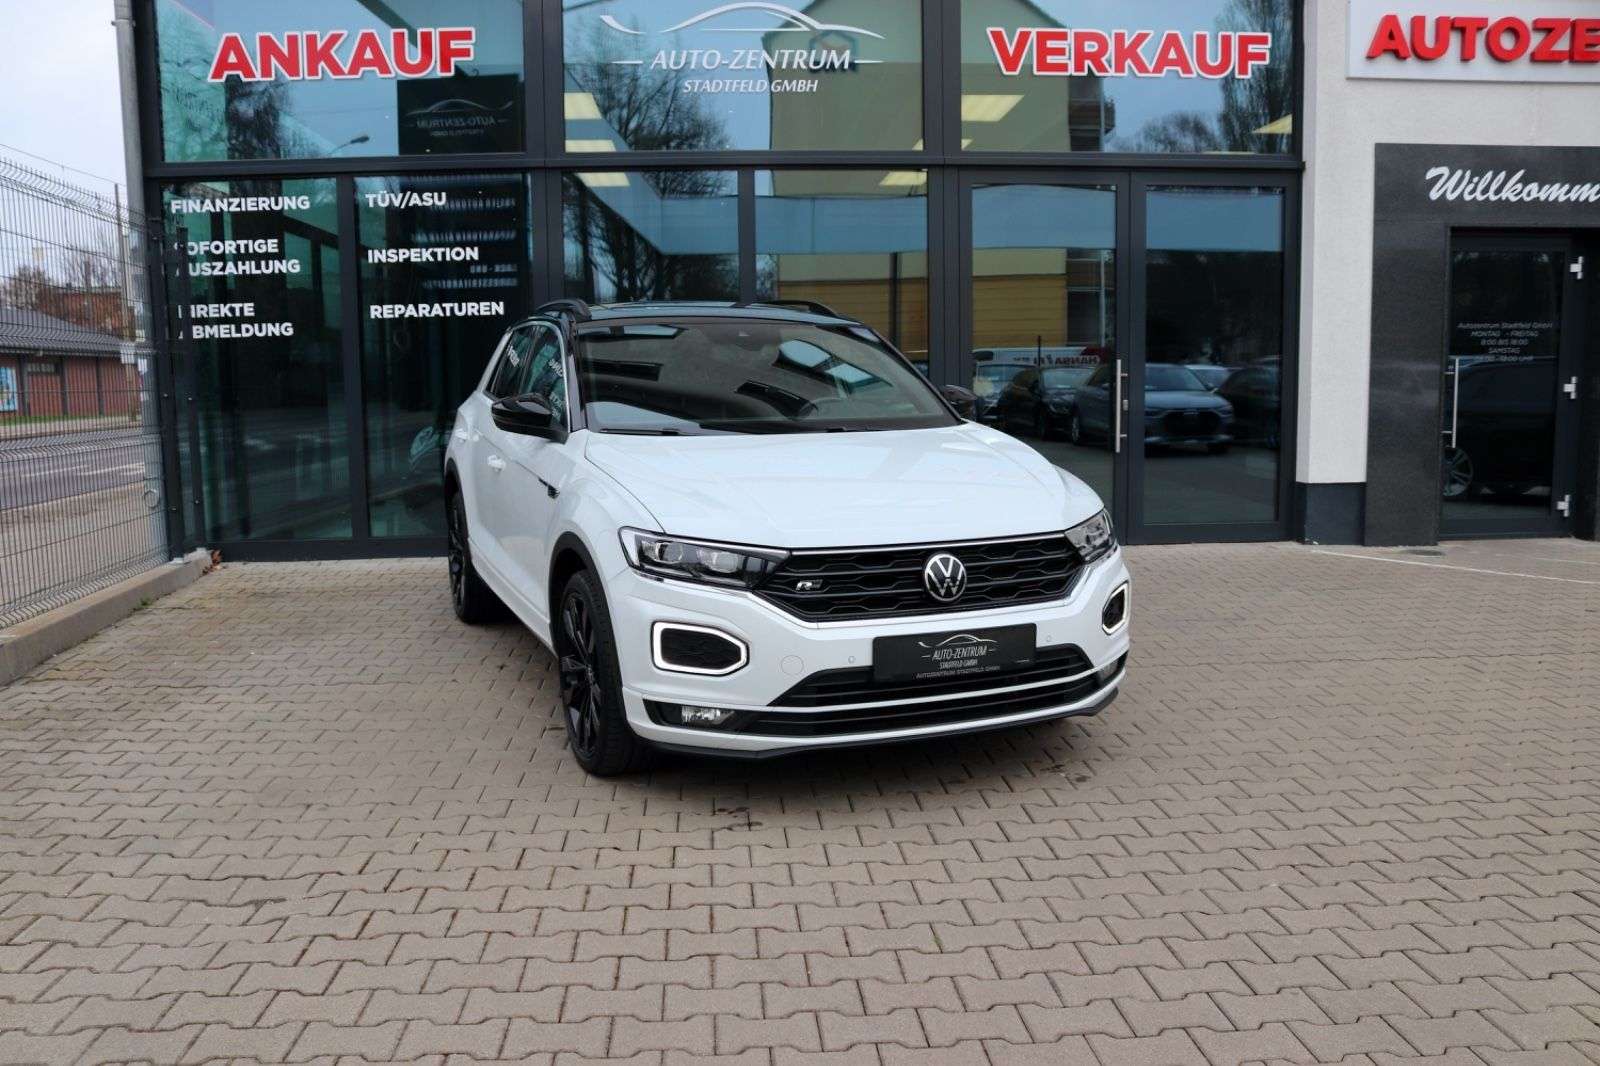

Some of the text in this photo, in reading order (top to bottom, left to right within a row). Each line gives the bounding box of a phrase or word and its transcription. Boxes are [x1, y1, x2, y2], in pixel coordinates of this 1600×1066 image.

[1365, 14, 1600, 64] AUTOZE
[208, 27, 475, 82] ANKAUF
[650, 49, 851, 71] AUTO-ZENTRUM
[986, 27, 1271, 79] VERKAUF
[683, 78, 819, 93] STADTFELD GMBH
[1425, 165, 1600, 203] Willkomm
[171, 195, 311, 214] FINANZIERUNG
[365, 190, 447, 209] TÜV/ASU
[174, 238, 279, 256] OFORTIGE
[367, 246, 479, 263] INSPEKTION
[175, 259, 301, 277] USZAHLUNG
[178, 302, 255, 319] IREKTE
[369, 301, 505, 319] REPARATUREN
[178, 321, 294, 340] BMELDUNG
[932, 645, 988, 661] AUTO-ZENTRUM
